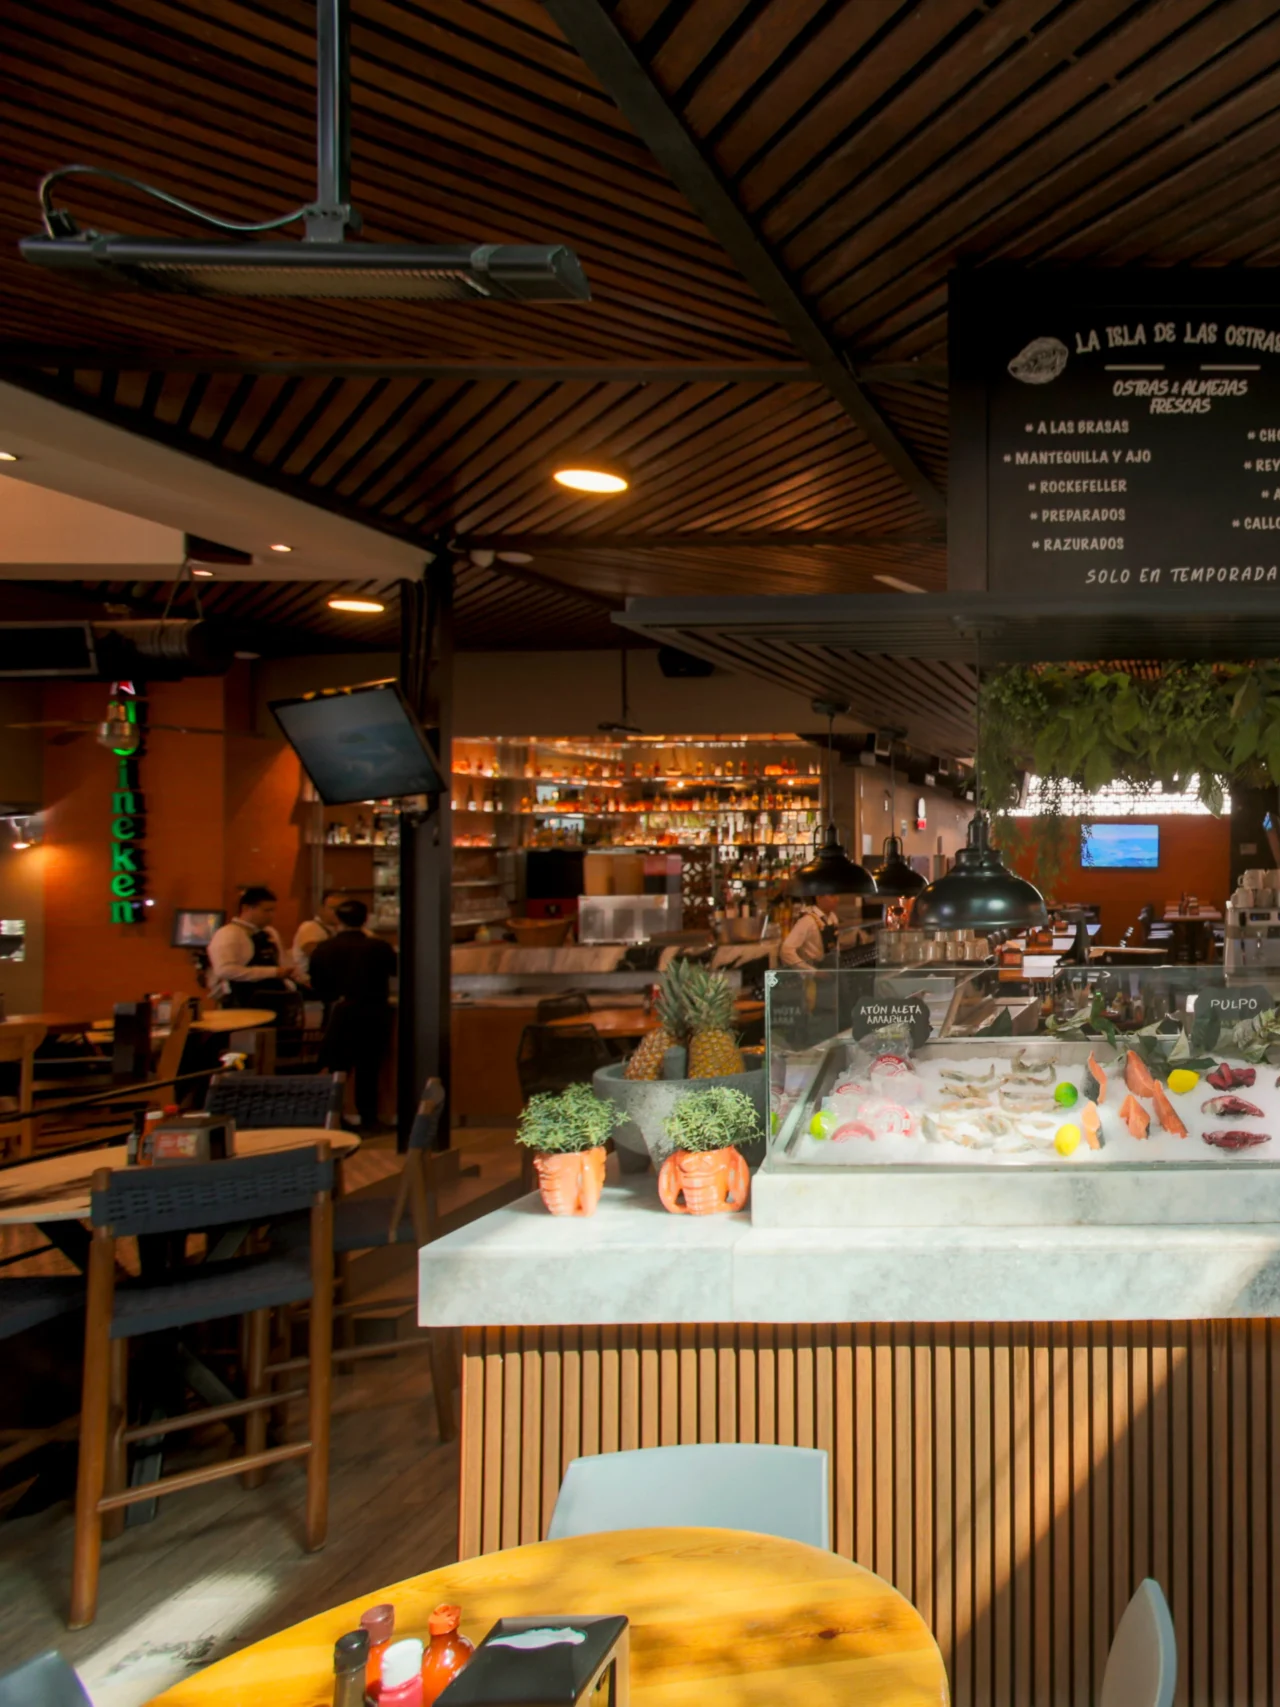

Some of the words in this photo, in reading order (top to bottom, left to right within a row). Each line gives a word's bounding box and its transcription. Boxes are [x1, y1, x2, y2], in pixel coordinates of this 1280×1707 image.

[1075, 329, 1101, 354] LA
[1106, 323, 1146, 348] ISLA
[1154, 322, 1176, 343] DE
[1184, 322, 1218, 344] LAS
[1113, 379, 1169, 396] OSTRAS
[1171, 382, 1180, 394] &
[1181, 379, 1248, 396] ALMEJAS
[1149, 397, 1211, 414] FRESCAS
[1037, 421, 1047, 434] A
[1050, 421, 1075, 434] LAS
[1077, 420, 1130, 434] BRASAS
[1015, 451, 1109, 465] MANTEQUILLA
[1112, 450, 1122, 462] Y
[1125, 450, 1151, 463] AJO
[1040, 479, 1127, 493] ROCKEFELLER
[1041, 508, 1126, 522] PREPARADOS
[1044, 538, 1124, 551] RAZURADOS
[1085, 569, 1130, 584] SOLO
[1171, 566, 1278, 583] TEMPORADA
[891, 1005, 922, 1014] ALETA
[1210, 998, 1257, 1010] PULPO
